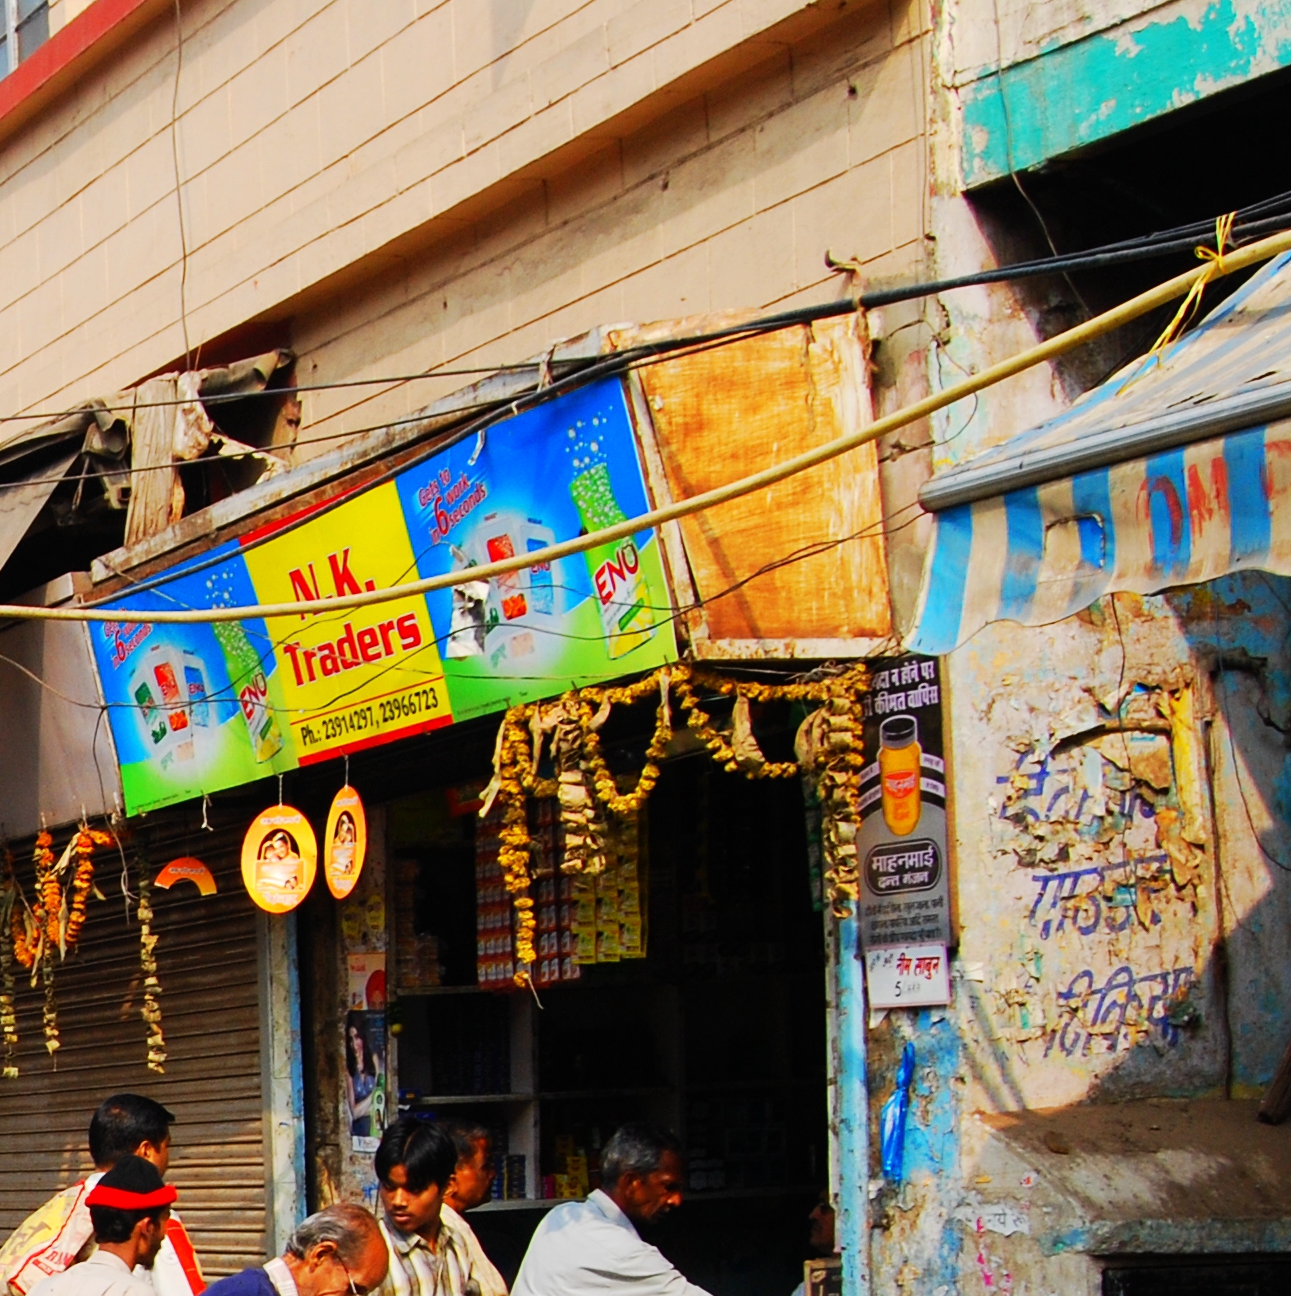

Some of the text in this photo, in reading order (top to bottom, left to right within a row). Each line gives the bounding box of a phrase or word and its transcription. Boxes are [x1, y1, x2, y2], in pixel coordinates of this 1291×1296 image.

[593, 543, 639, 605] ENO
[283, 611, 422, 688] Traders
[239, 672, 268, 720] ENO
[382, 687, 439, 723] 23966723
